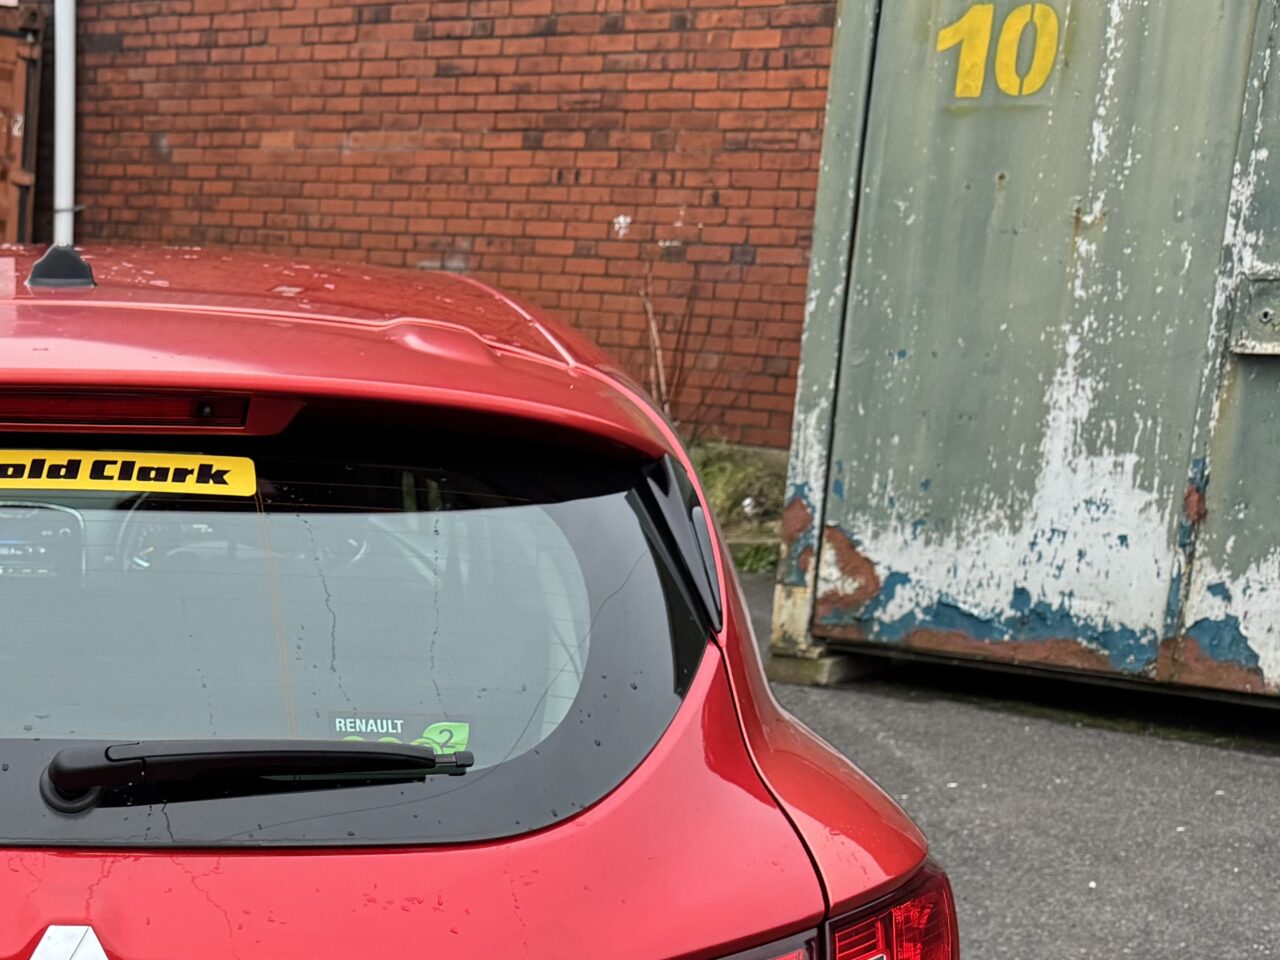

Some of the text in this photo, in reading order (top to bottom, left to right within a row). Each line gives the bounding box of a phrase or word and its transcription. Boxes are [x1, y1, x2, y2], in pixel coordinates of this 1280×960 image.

[936, 3, 1059, 98] 10
[89, 459, 233, 486] Clark
[335, 718, 404, 734] RENAULT
